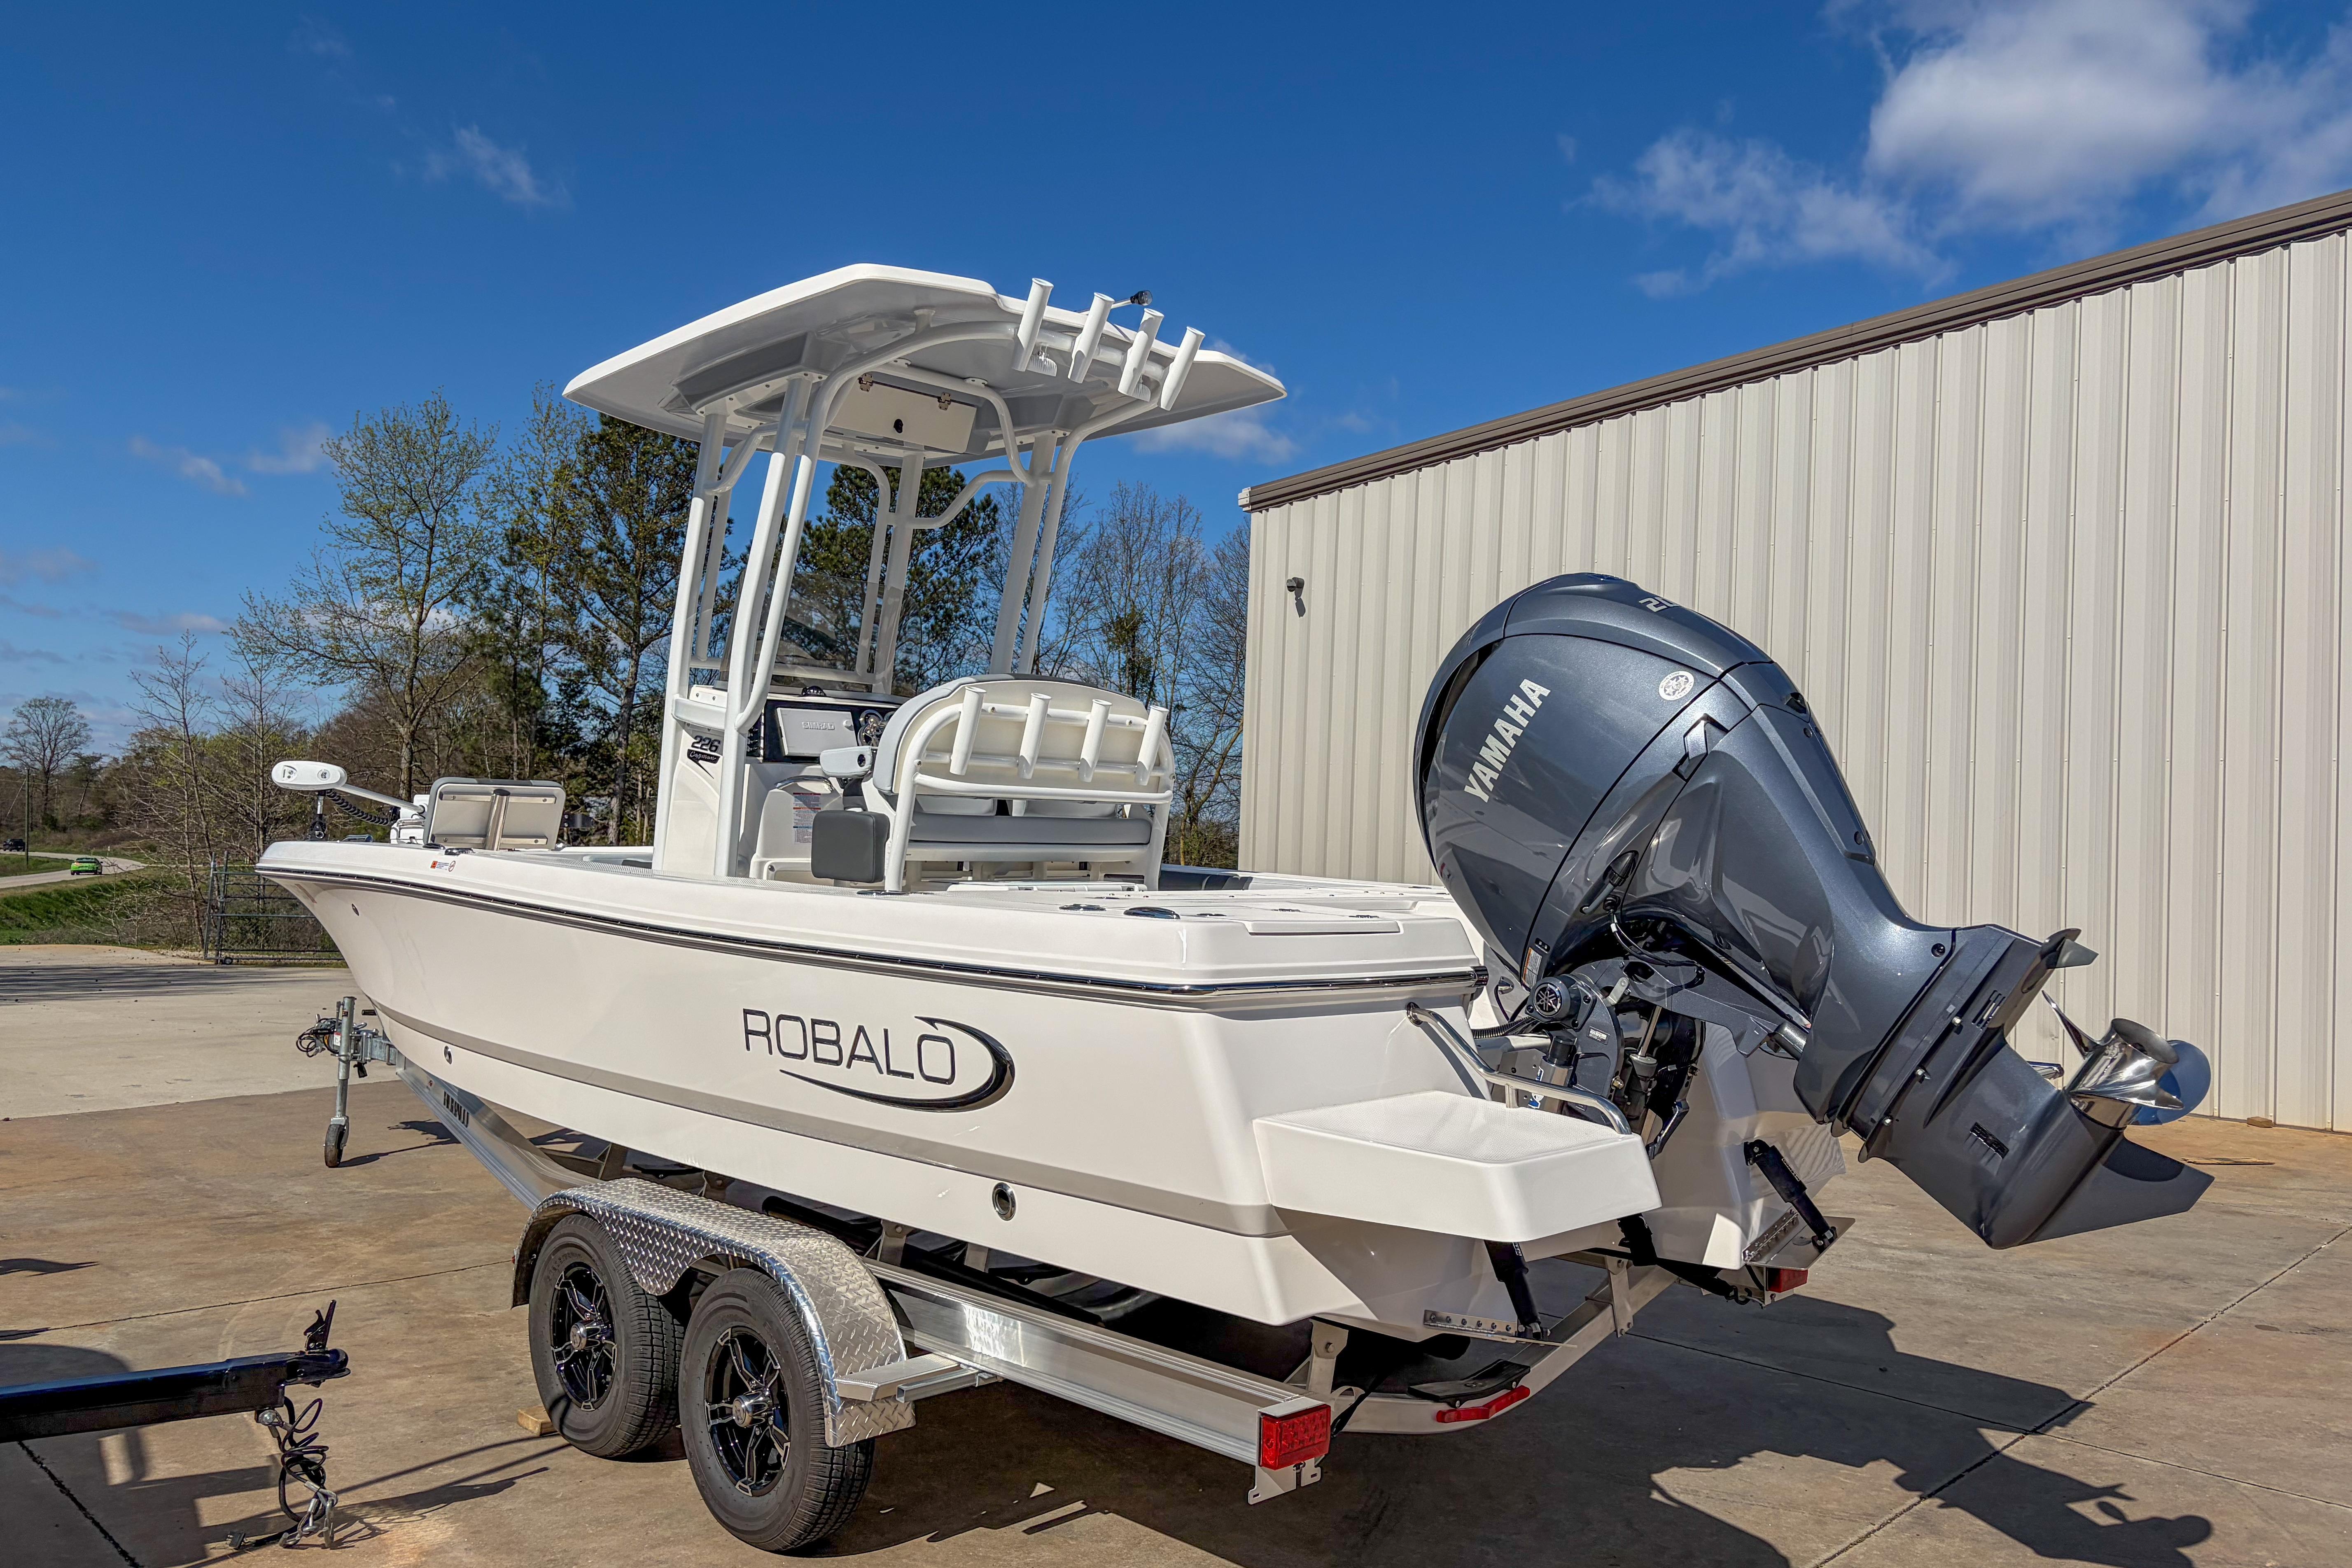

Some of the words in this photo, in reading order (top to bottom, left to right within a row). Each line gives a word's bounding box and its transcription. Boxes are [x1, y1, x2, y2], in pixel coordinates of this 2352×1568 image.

[691, 735, 721, 752] 226
[802, 721, 835, 730] SIMRAD
[1464, 678, 1551, 803] YAMAHA
[743, 1008, 956, 1085] ROBALO
